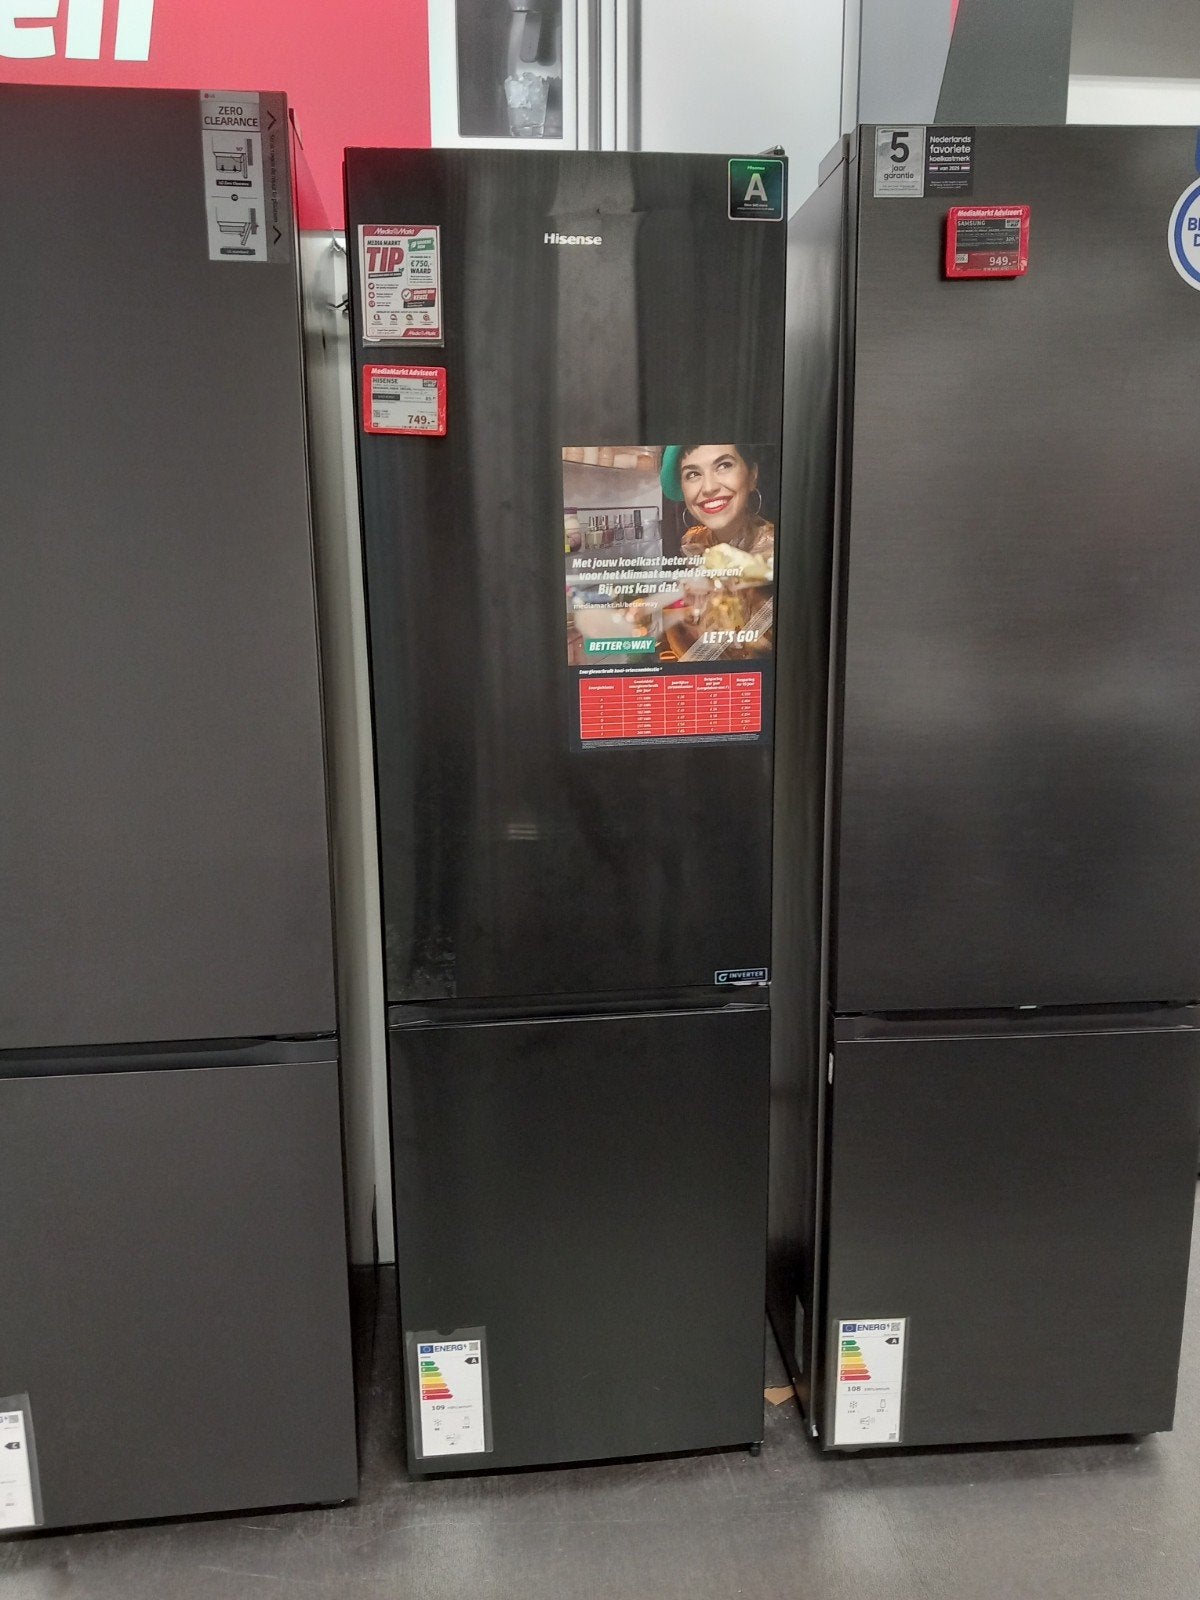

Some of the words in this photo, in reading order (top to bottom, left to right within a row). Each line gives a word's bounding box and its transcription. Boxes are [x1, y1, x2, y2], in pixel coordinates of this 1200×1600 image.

[218, 106, 243, 116] ZERO
[204, 116, 259, 127] CLEARANCE
[929, 135, 972, 144] Nederlands
[890, 131, 910, 163] 5
[929, 144, 971, 154] favoriete
[928, 155, 971, 163] koelkastmerk
[891, 165, 907, 173] jaar
[883, 171, 914, 181] garantie
[743, 173, 768, 202] A
[957, 209, 995, 217] MediaMarkt
[543, 232, 603, 246] Hisense
[366, 246, 405, 273] TIP
[371, 367, 409, 376] MediaMarkt
[408, 368, 438, 378] Adviseert
[407, 414, 435, 425] 749.-
[571, 558, 591, 568] Met
[591, 557, 618, 569] jouw
[618, 556, 661, 568] koelkast
[660, 555, 687, 566] beter
[687, 554, 706, 568] zijn
[579, 571, 603, 581] voor
[602, 570, 620, 581] het
[620, 569, 659, 580] klimaat
[659, 570, 671, 579] en
[672, 567, 694, 580] geld
[694, 566, 744, 580] besparen?
[597, 583, 614, 596] Bij
[614, 585, 635, 595] ons
[635, 582, 657, 594] kan
[657, 582, 680, 593] dat.
[573, 601, 659, 611] mediamarkt.nl/betterway
[702, 630, 735, 644] LET'S
[736, 630, 759, 643] GO!
[588, 640, 623, 652] BETTER
[630, 640, 653, 650] WAY
[857, 1323, 886, 1332] ENERG
[434, 1344, 463, 1353] ENERG
